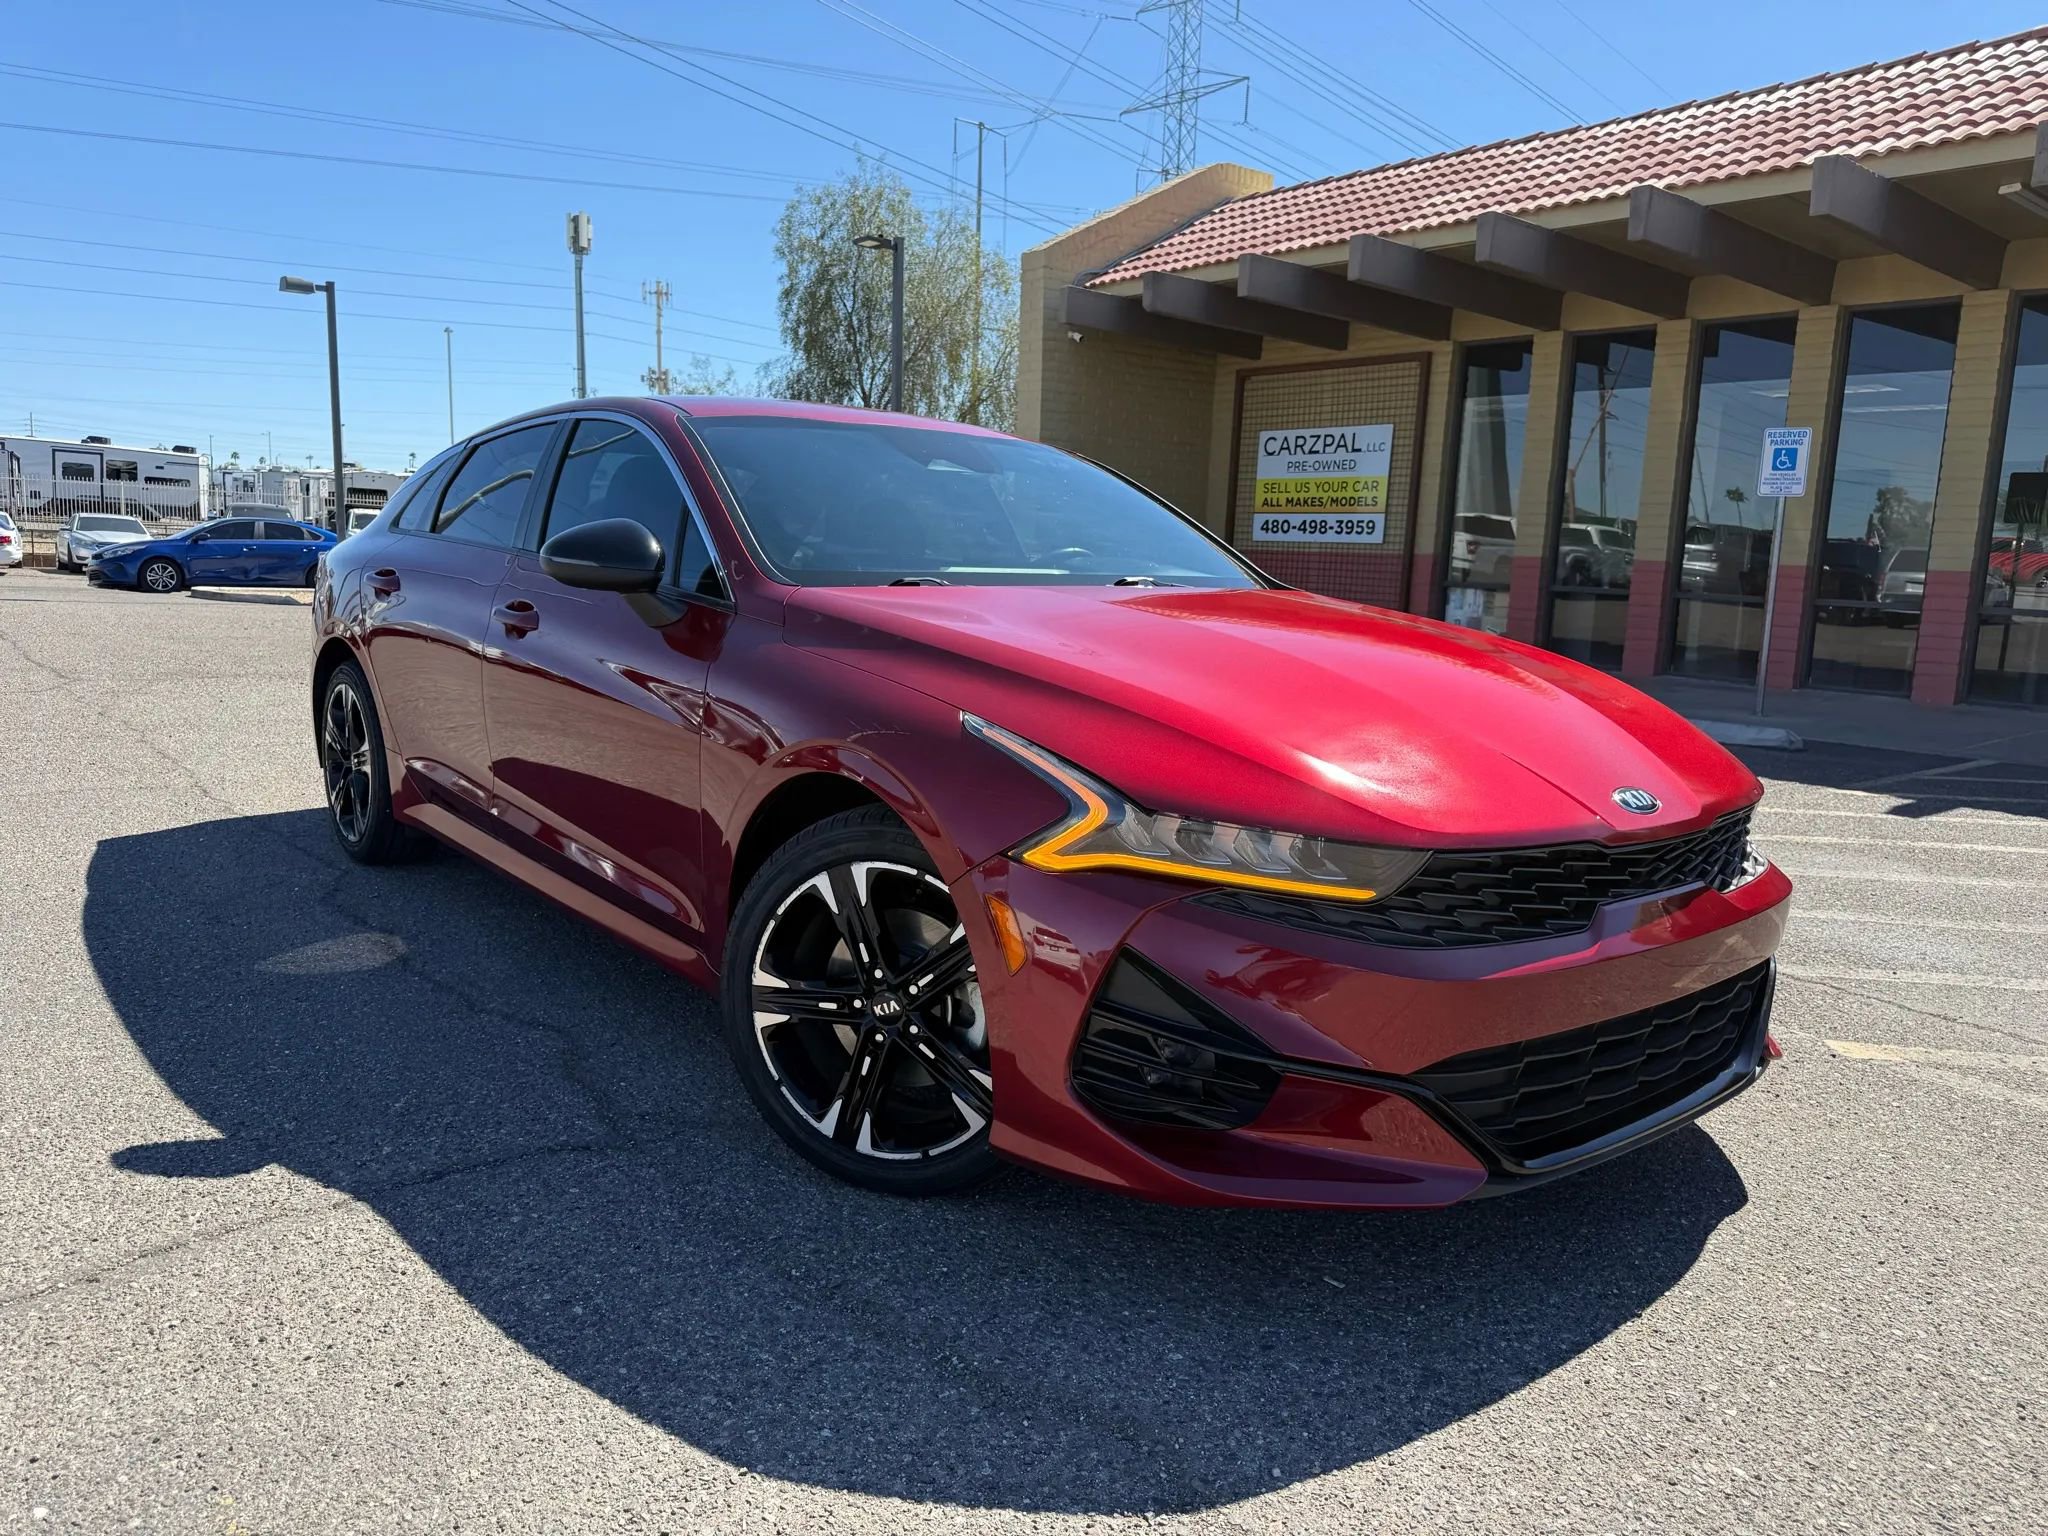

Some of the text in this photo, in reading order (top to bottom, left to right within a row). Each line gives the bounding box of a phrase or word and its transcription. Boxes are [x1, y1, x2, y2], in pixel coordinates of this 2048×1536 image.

[1767, 430, 1808, 439] RESERVED
[1263, 432, 1386, 456] CARZPAL LLC
[1769, 438, 1804, 446] PARKING
[1287, 459, 1357, 472] PRE-OWNED
[1263, 480, 1379, 494] SELL US YOUR CAR
[1261, 496, 1378, 509] ALL MAKES/MODELS
[1260, 519, 1376, 535] 480-498-3959
[1619, 789, 1658, 808] KIA
[873, 1000, 901, 1017] KIA
